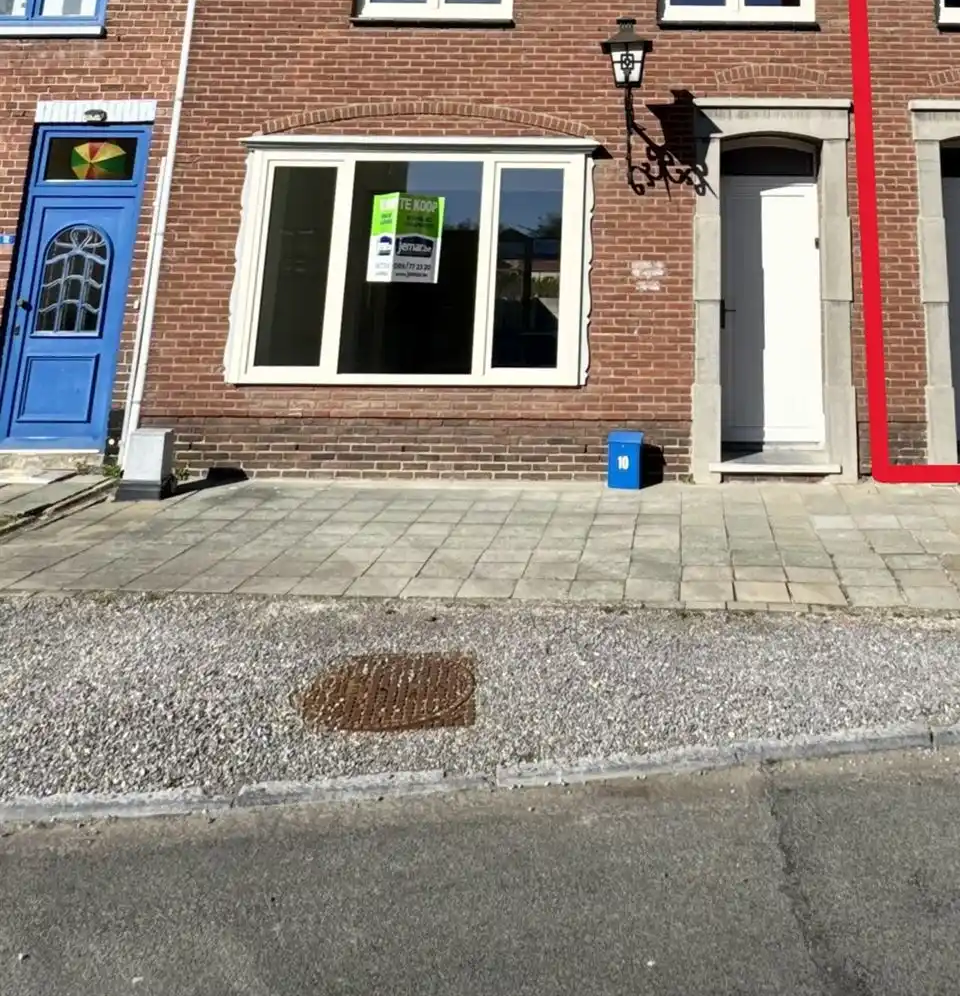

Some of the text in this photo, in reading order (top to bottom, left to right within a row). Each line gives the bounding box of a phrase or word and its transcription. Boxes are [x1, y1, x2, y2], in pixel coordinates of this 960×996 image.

[400, 197, 412, 210] TE
[412, 199, 437, 212] KOOP
[617, 455, 629, 470] 10
